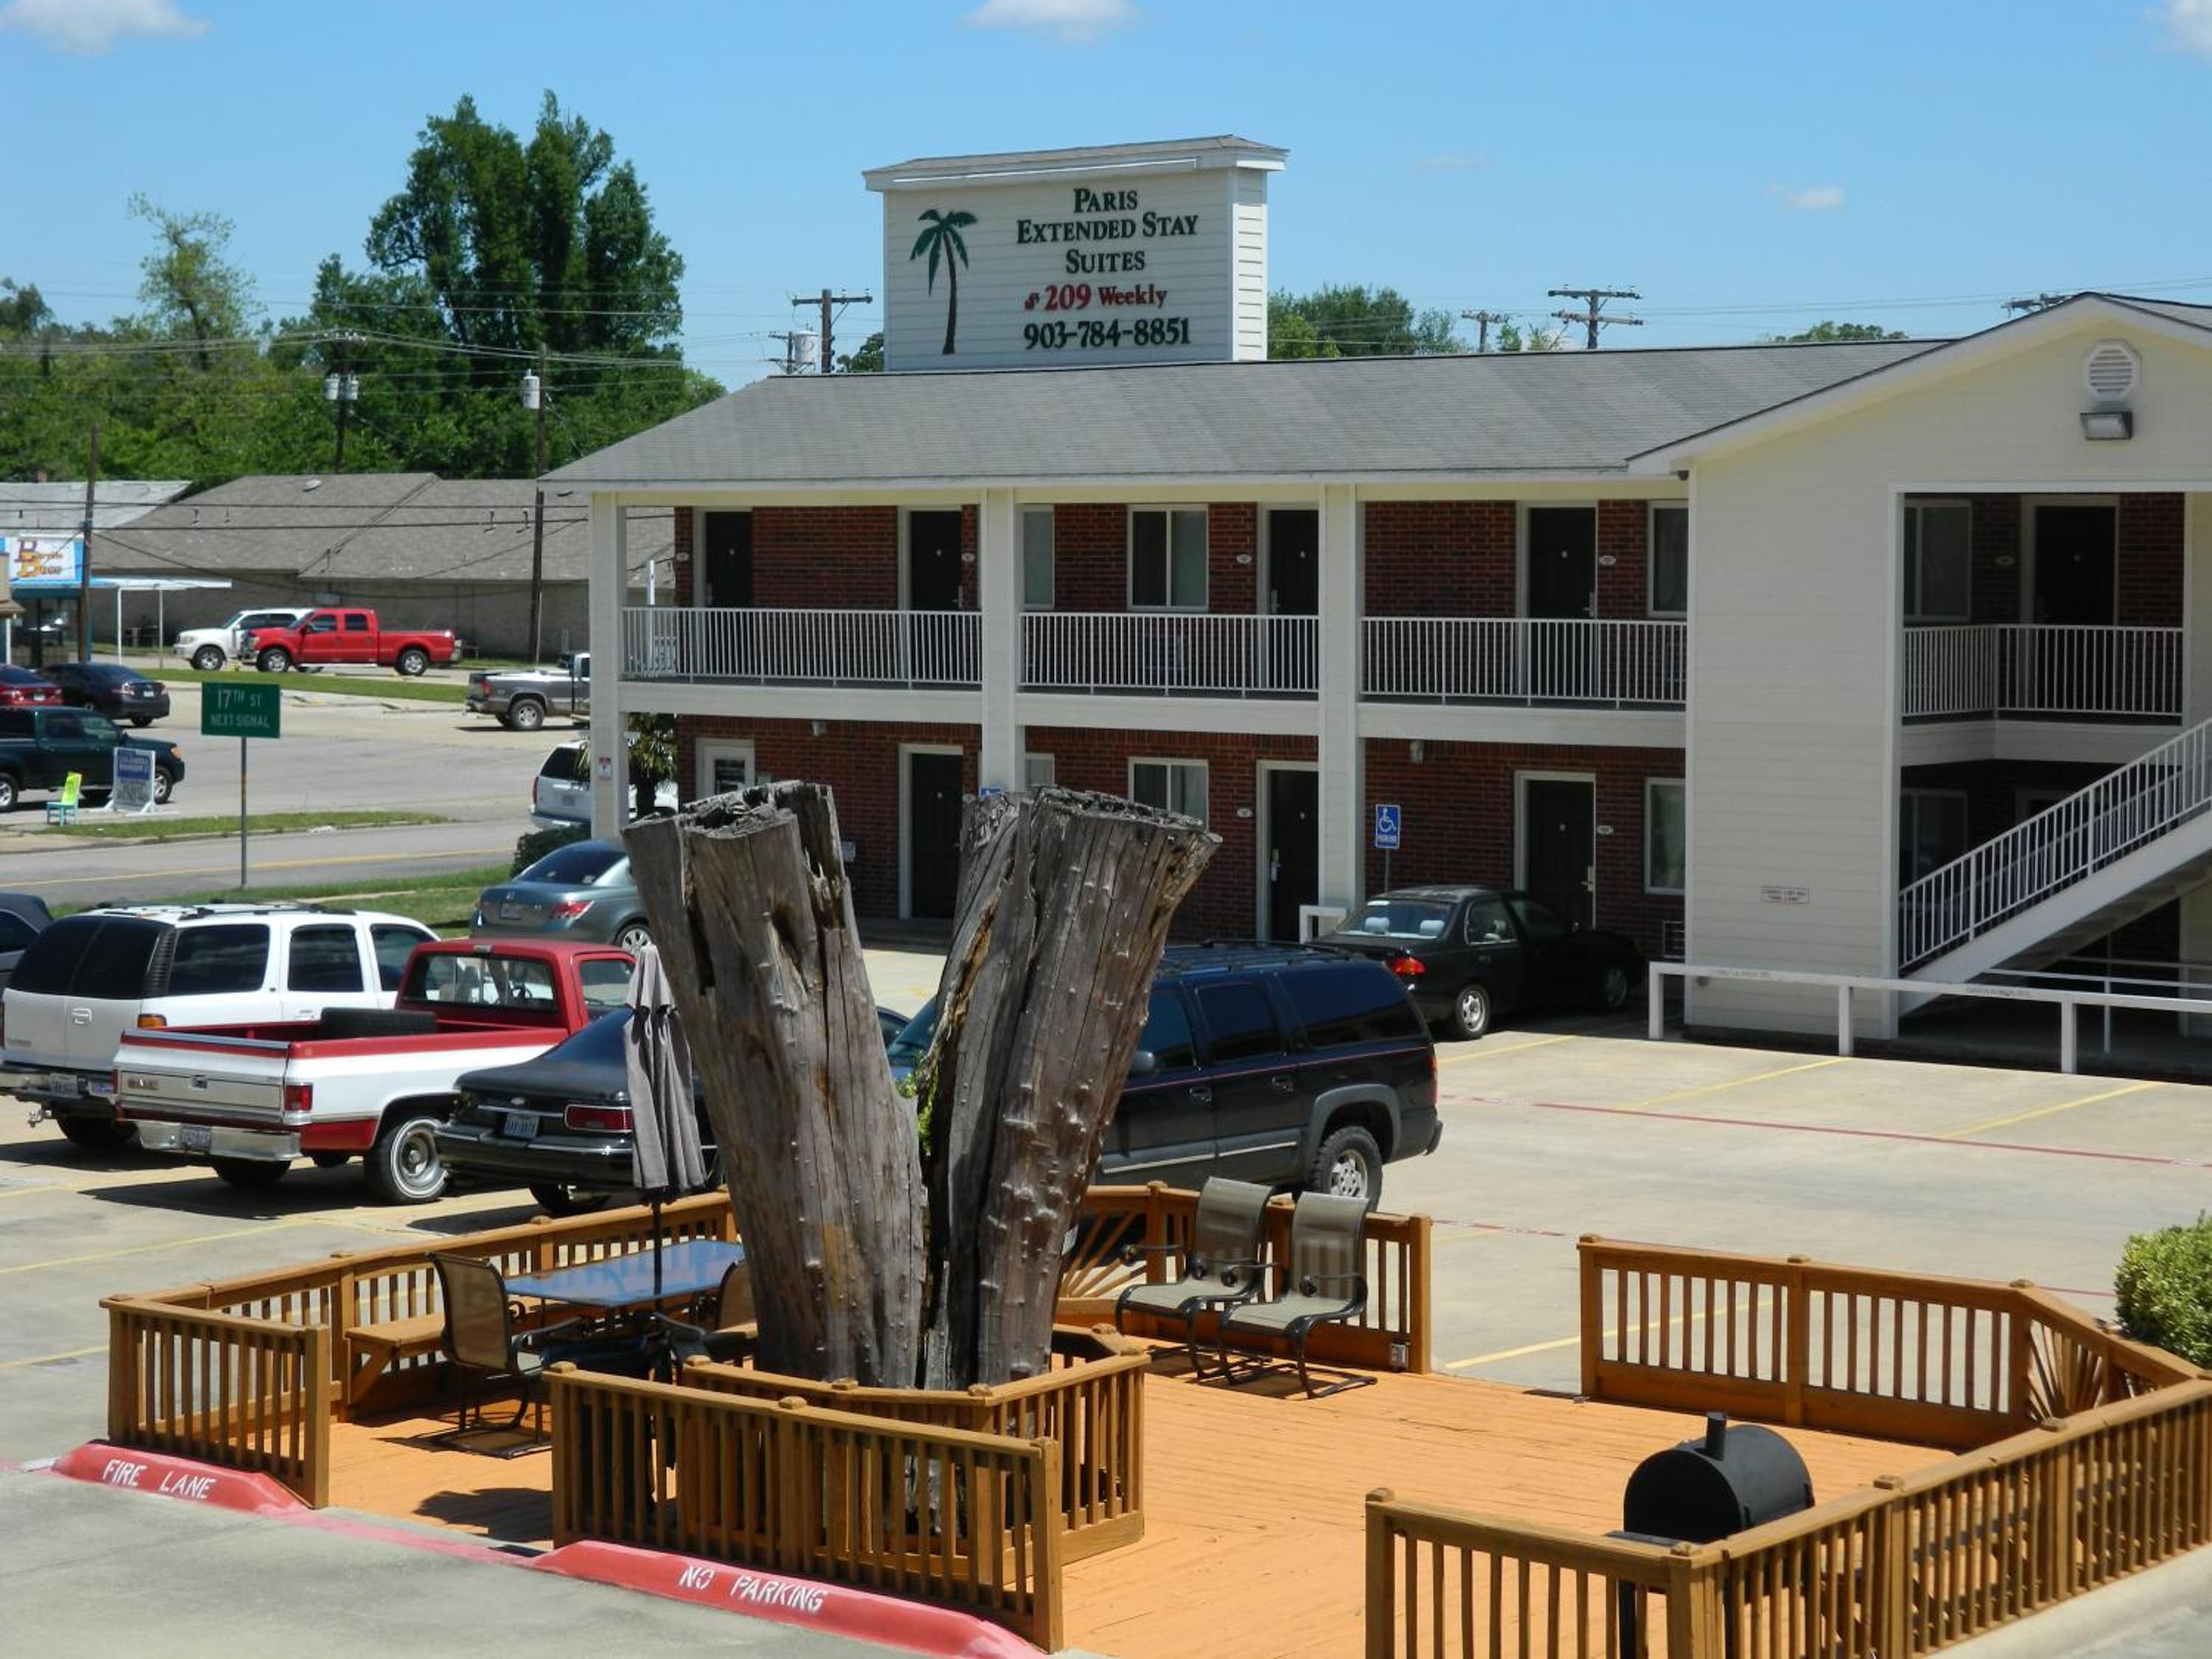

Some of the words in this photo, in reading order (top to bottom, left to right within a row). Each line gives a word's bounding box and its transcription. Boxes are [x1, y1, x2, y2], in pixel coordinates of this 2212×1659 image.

[1073, 188, 1138, 214] PARIS
[1016, 218, 1137, 244] EXTENDED
[1142, 211, 1200, 237] STAY
[1065, 248, 1146, 274] SUITES
[1098, 283, 1168, 310] Weekly
[1023, 318, 1191, 350] 903-784-8851
[217, 689, 246, 709] 17TH
[235, 713, 271, 729] SIGNAL
[102, 1458, 147, 1487] FIRE
[159, 1470, 218, 1499] LANE
[678, 1565, 715, 1590] NO
[730, 1574, 828, 1613] PARKING
